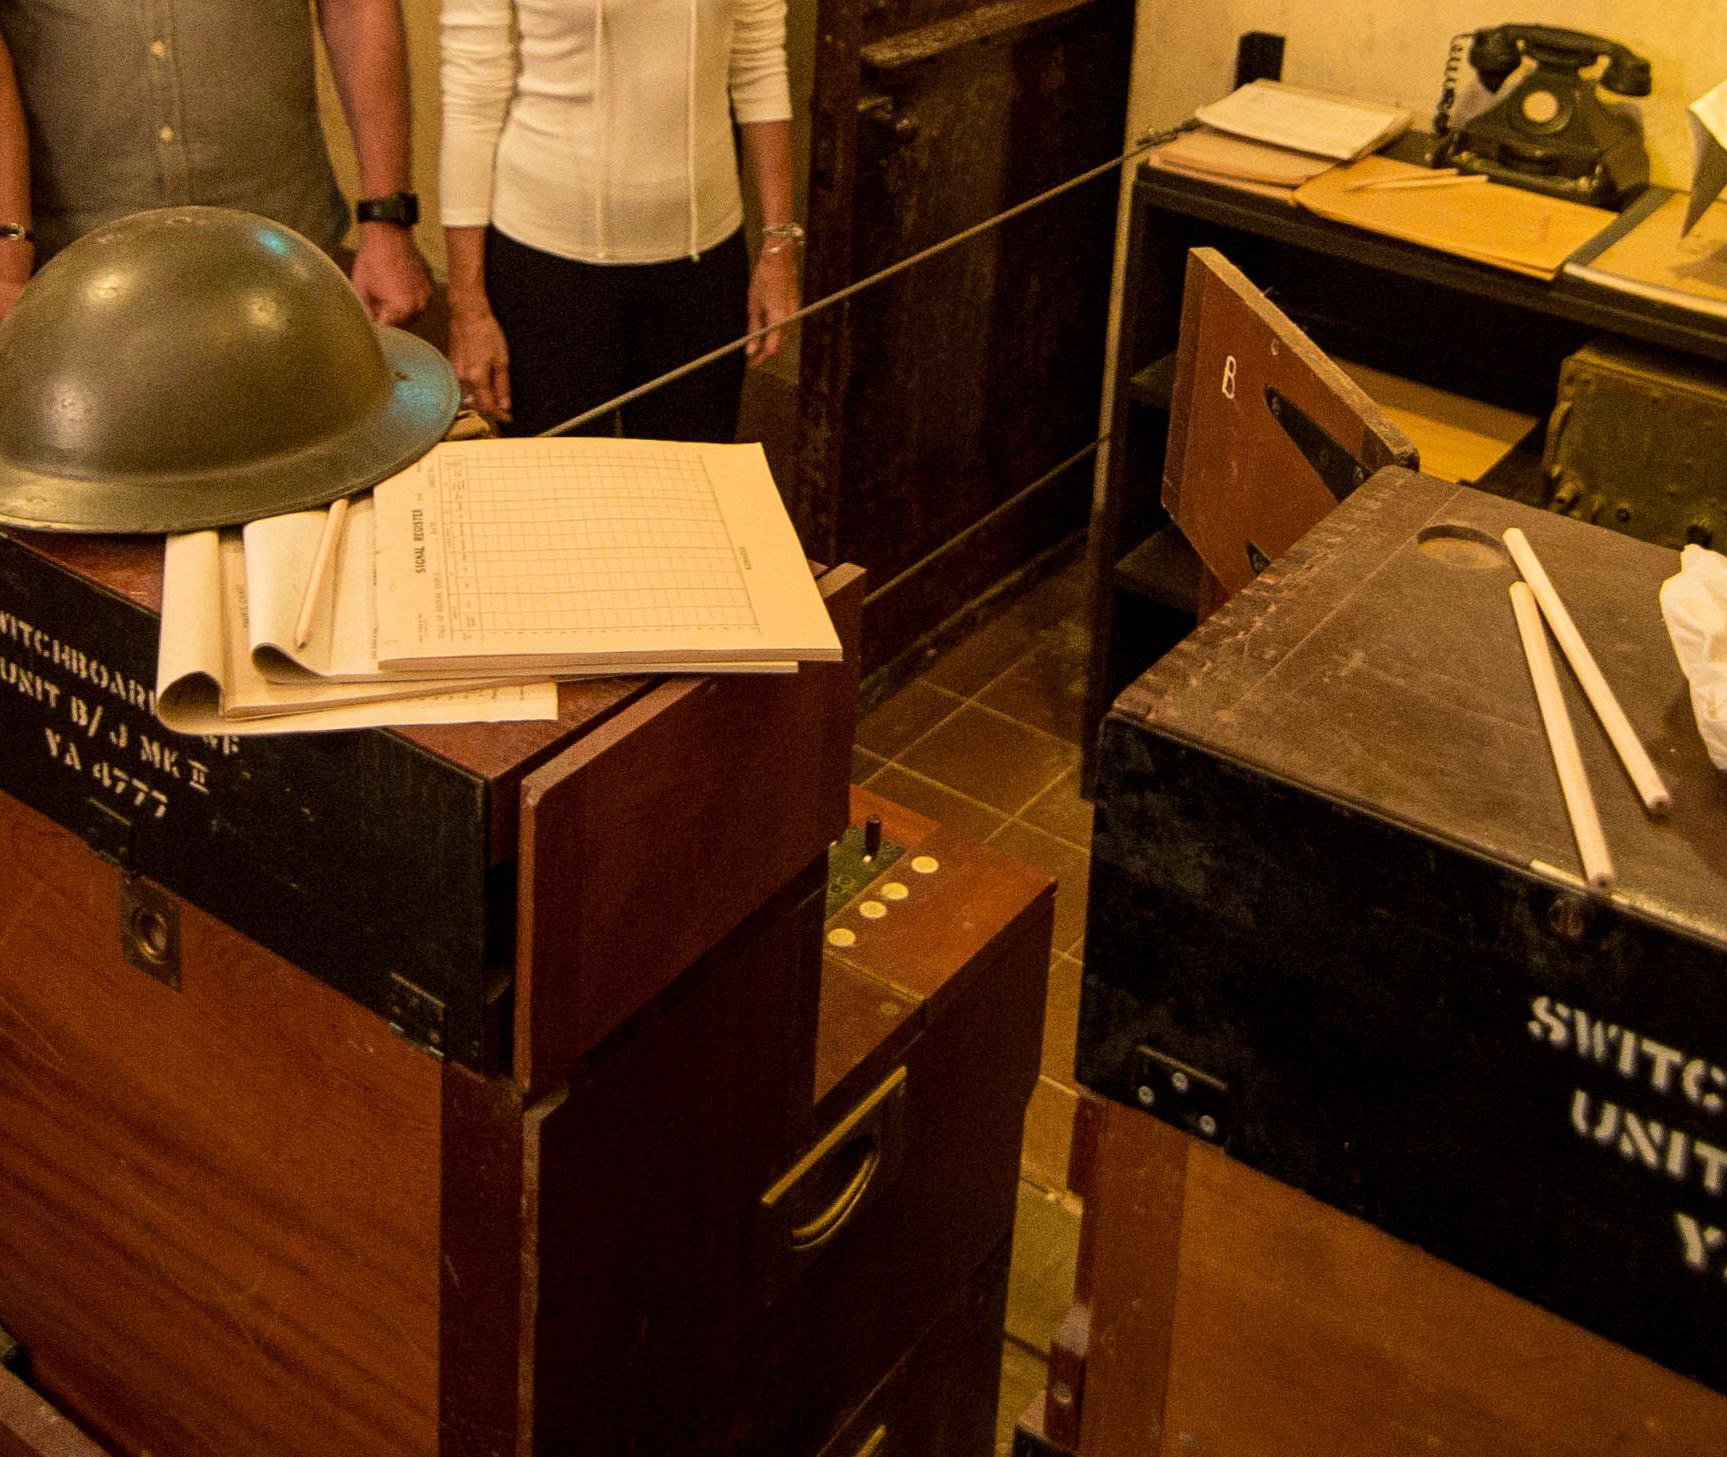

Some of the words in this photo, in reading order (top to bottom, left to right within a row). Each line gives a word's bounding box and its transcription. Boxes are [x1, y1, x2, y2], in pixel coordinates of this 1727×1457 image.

[412, 509, 424, 542] REGISTER
[415, 545, 426, 574] SIGNAL
[0, 656, 60, 709] UNIT
[140, 735, 180, 778] MK
[92, 761, 168, 818] 4777
